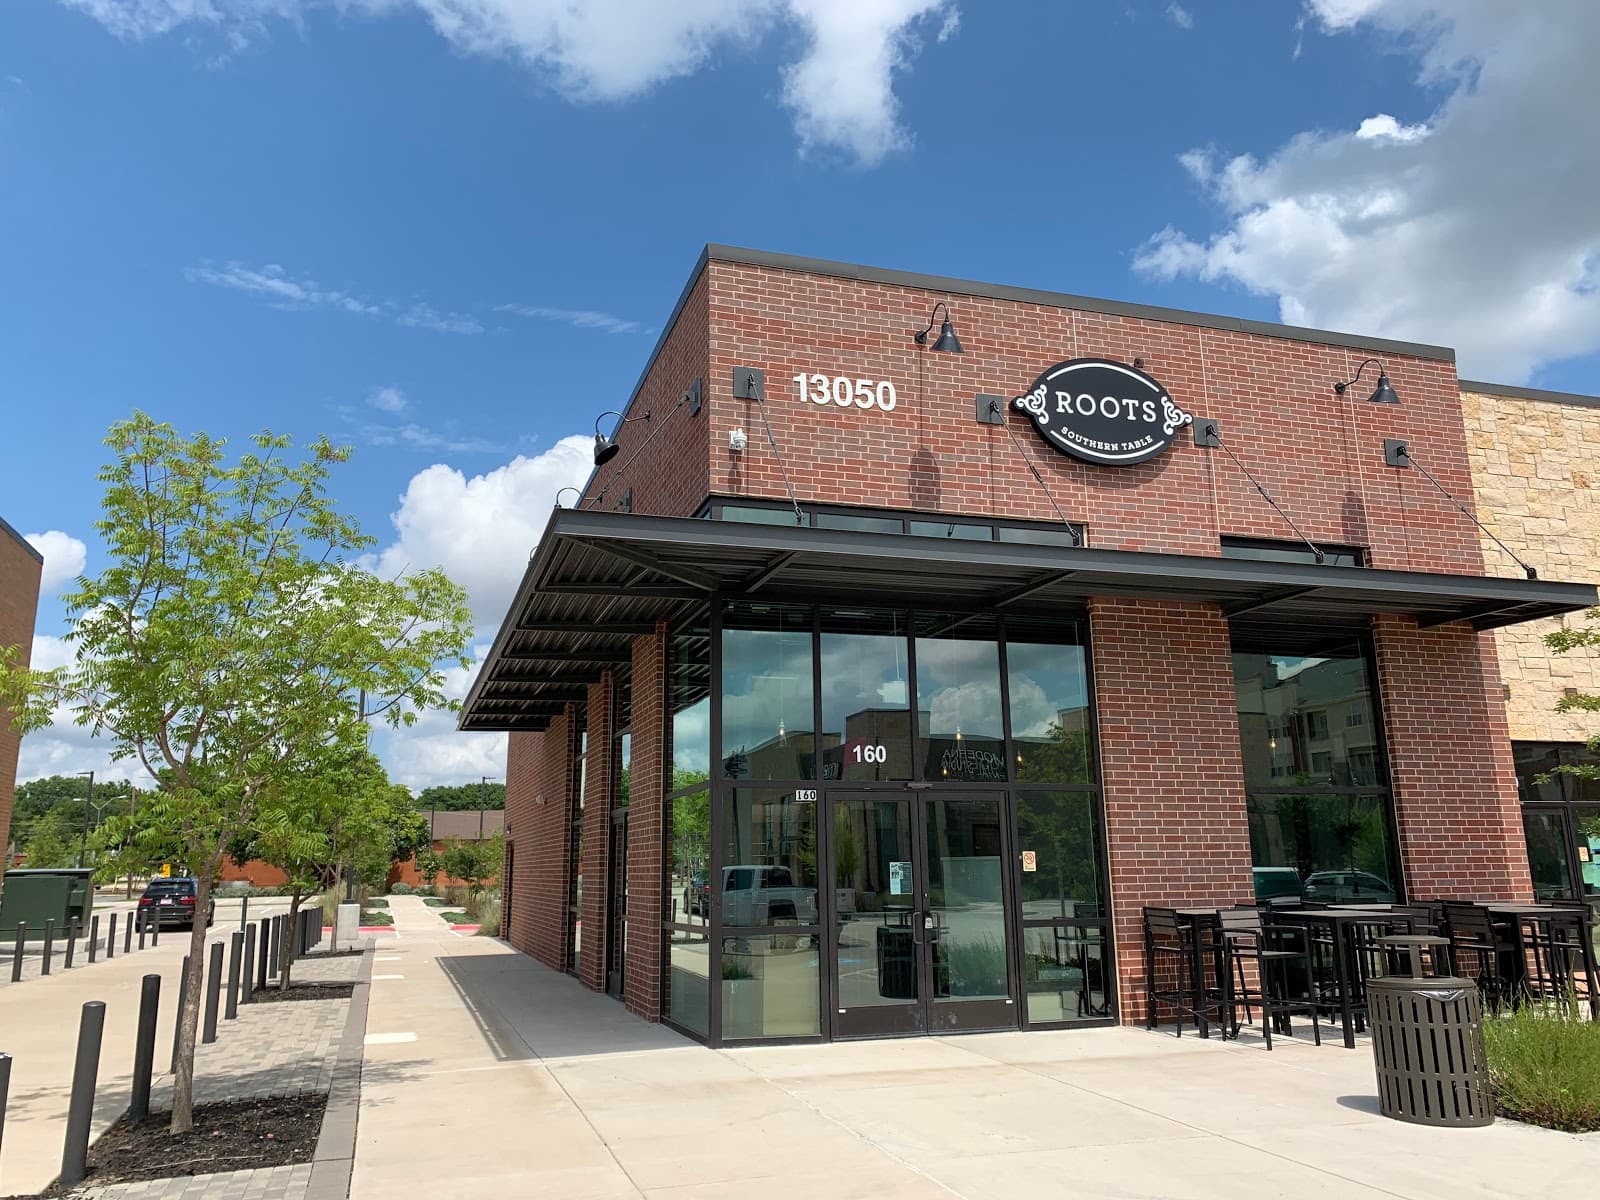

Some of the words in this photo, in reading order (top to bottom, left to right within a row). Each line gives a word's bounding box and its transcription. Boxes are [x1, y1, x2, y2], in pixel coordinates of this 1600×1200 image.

[793, 372, 897, 411] 13050
[1055, 391, 1156, 422] ROOTS
[1061, 426, 1119, 451] SOUTHERN
[1121, 434, 1153, 450] TABLE
[852, 745, 887, 763] 160
[797, 790, 816, 800] 160
